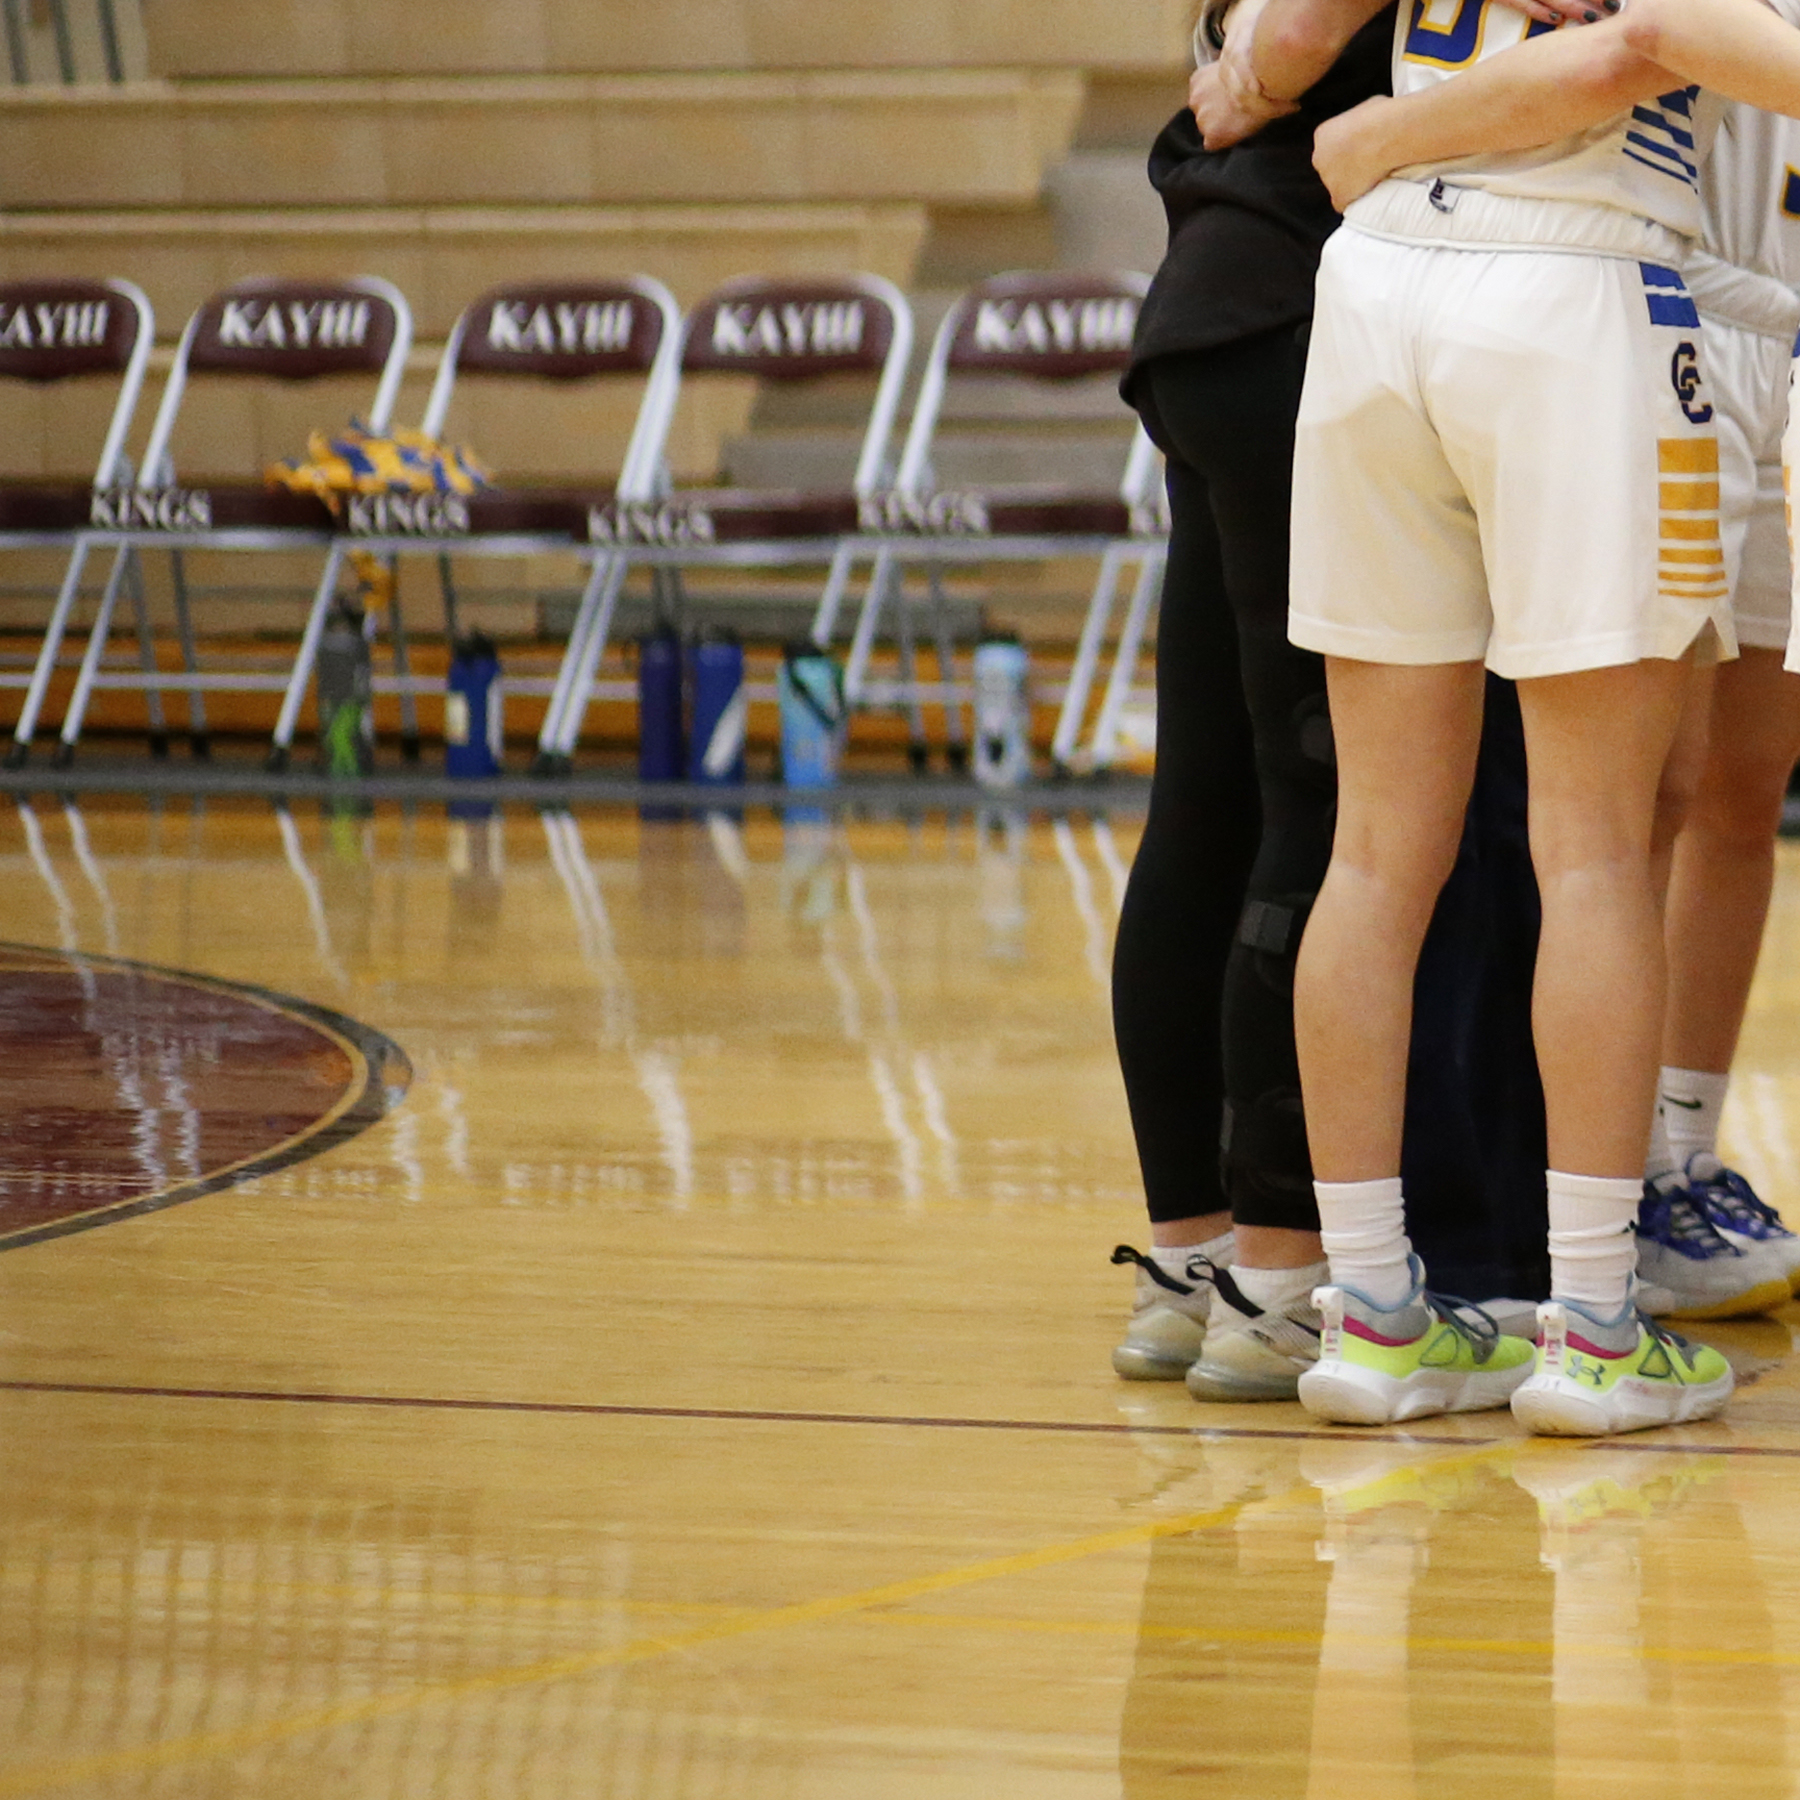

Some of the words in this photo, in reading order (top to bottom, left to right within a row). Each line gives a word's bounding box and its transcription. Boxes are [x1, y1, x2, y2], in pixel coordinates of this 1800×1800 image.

[0, 300, 108, 349] AYHI
[1671, 340, 1714, 426] CC
[90, 488, 213, 531] KINGS
[348, 495, 472, 534] KINGS
[587, 501, 717, 545] KINGS
[856, 490, 991, 534] KINGS
